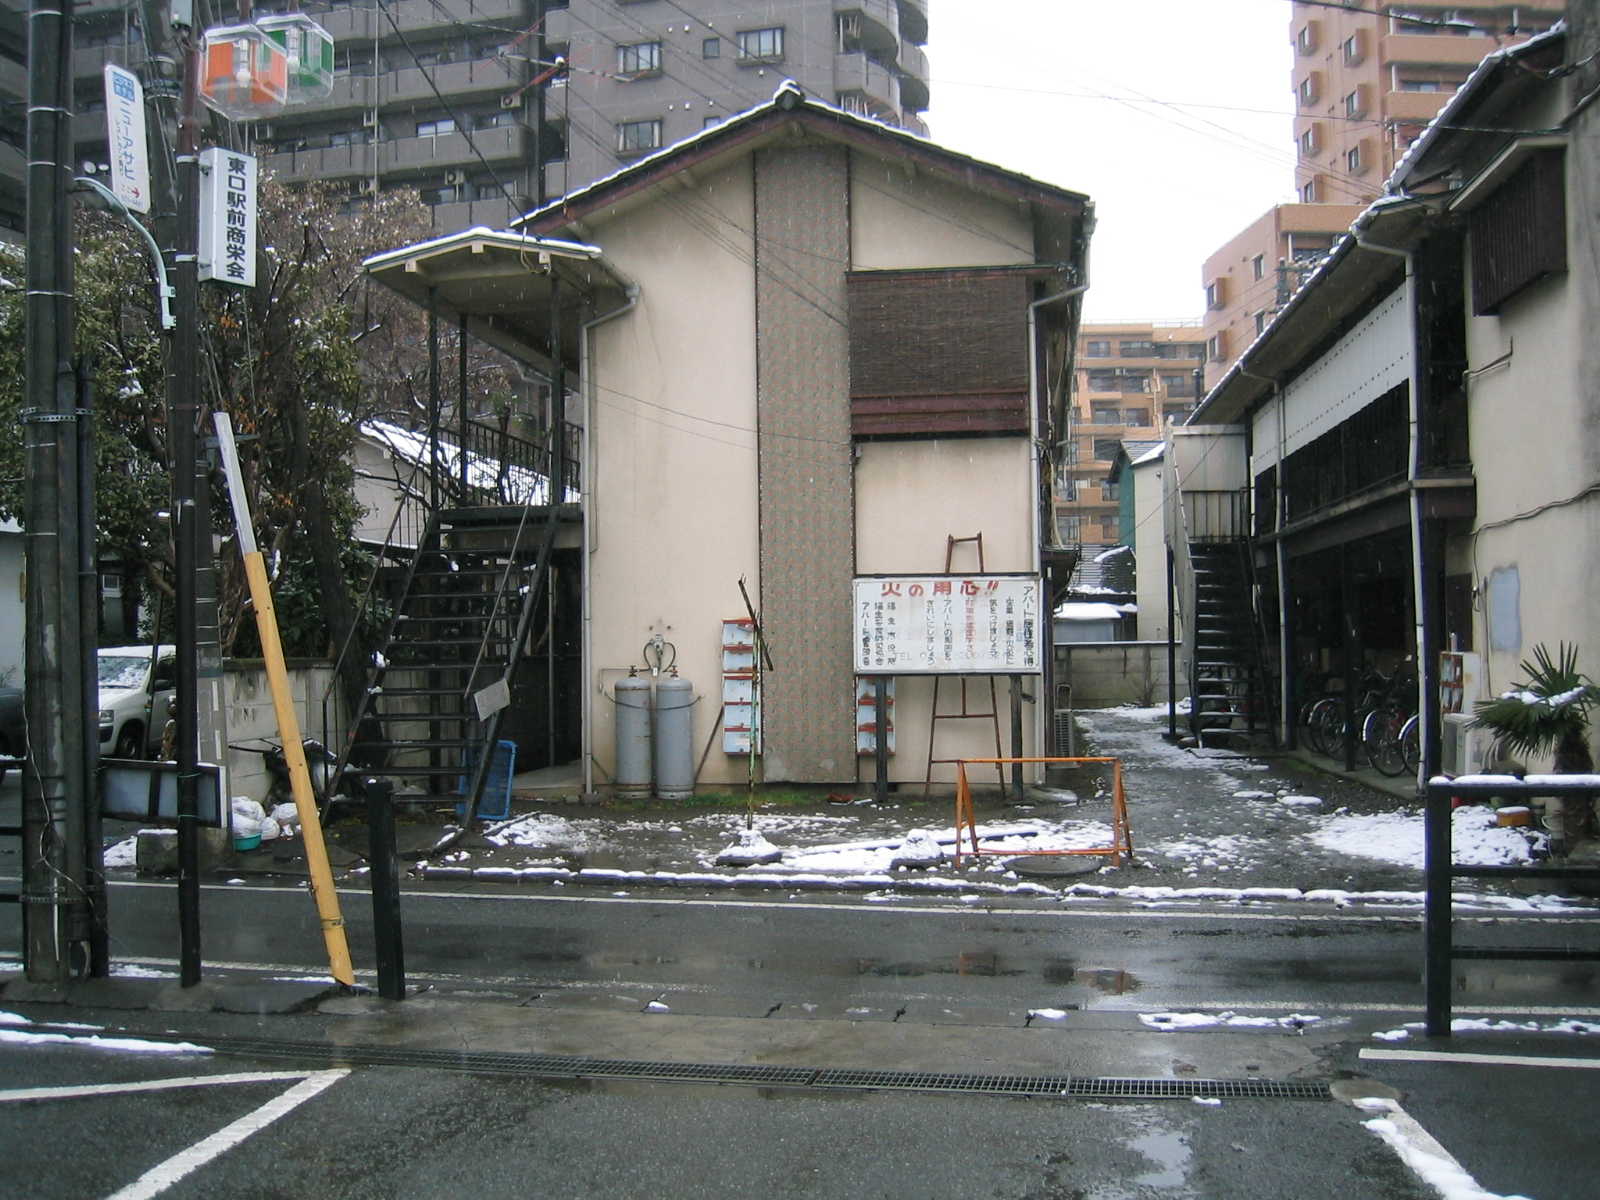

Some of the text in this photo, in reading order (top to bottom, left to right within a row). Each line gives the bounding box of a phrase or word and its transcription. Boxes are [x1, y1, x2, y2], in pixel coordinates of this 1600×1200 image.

[114, 85, 135, 101] ホテル
[120, 100, 135, 180] ニューアサヒ
[226, 157, 247, 280] 東口駅前商栄会
[926, 600, 935, 666] きれいにしましょう
[1022, 586, 1034, 666] アパート居住者心得
